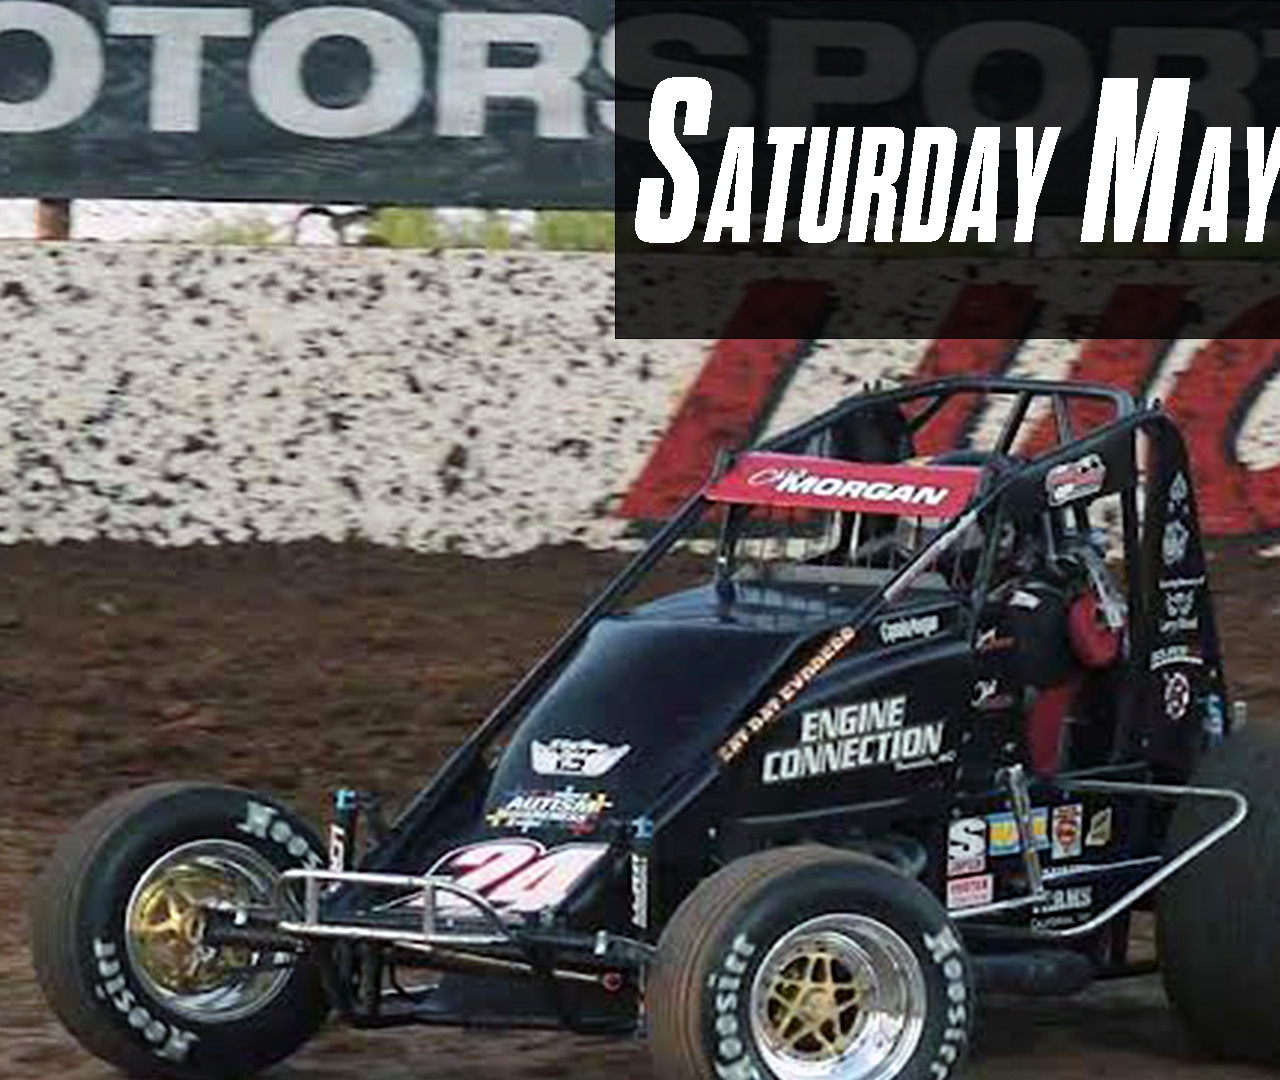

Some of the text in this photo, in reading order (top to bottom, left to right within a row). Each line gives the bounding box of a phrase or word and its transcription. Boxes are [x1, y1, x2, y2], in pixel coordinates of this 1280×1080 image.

[776, 473, 948, 505] MORGAN
[801, 696, 907, 744] ENGINE
[762, 721, 944, 784] CONNECTION
